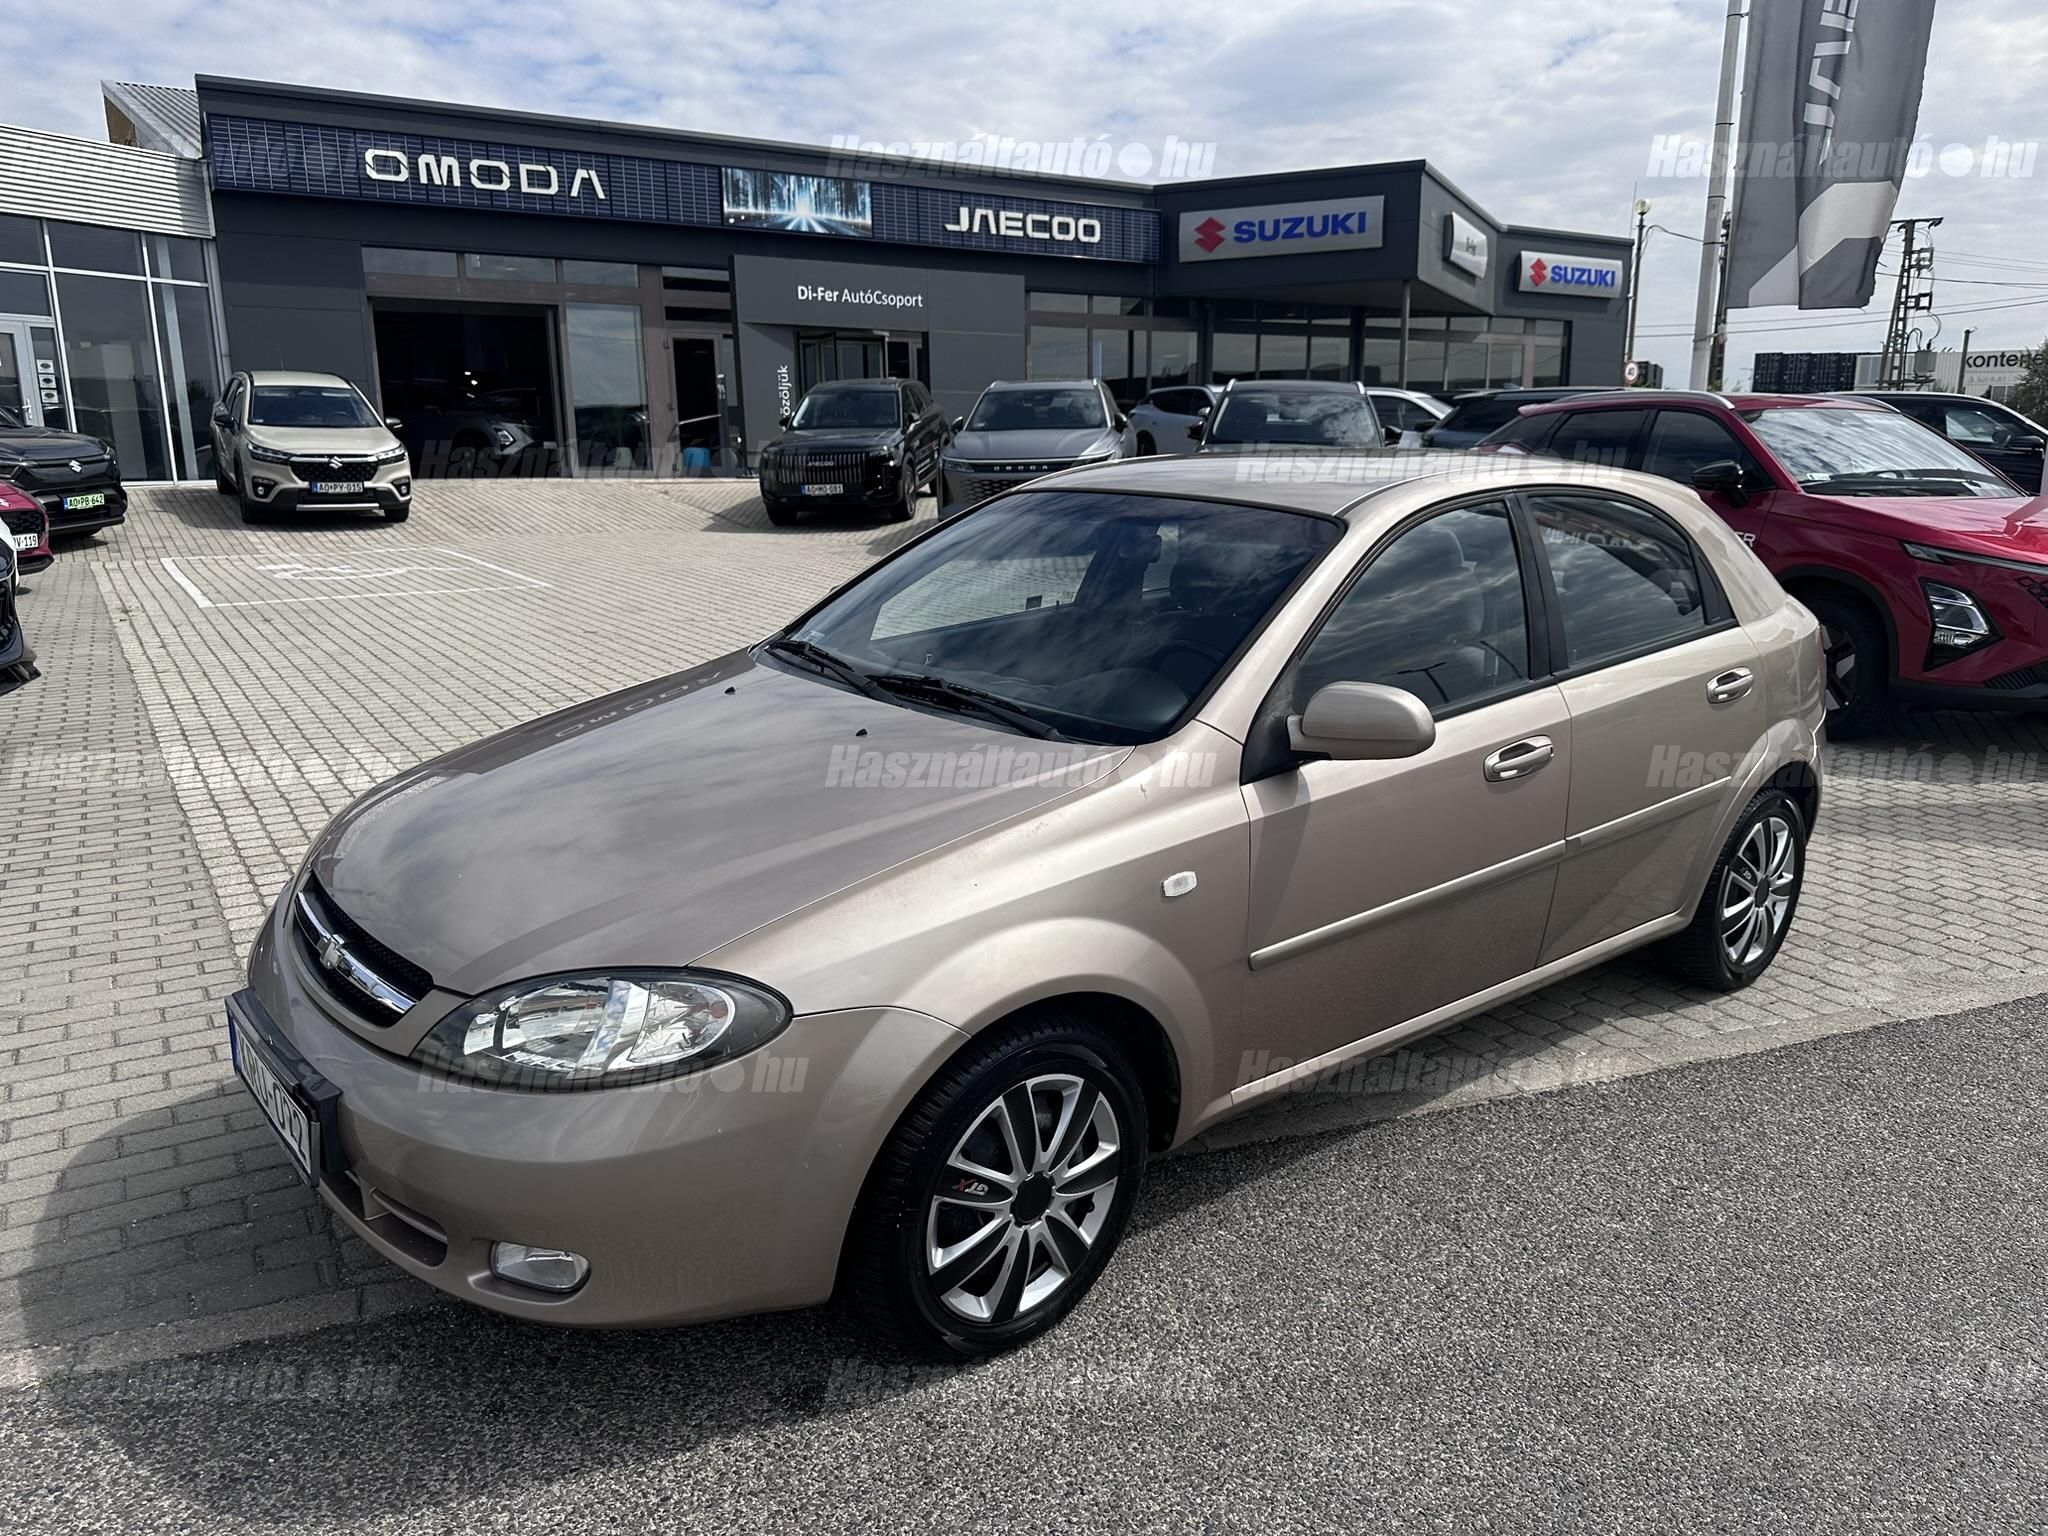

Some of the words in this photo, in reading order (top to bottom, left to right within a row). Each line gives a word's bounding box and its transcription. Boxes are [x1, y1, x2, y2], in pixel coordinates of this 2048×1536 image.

[365, 149, 606, 199] OMODA
[944, 207, 1101, 243] JAECOO
[1233, 211, 1367, 243] SUZUKI
[1550, 265, 1616, 288] SUZUKI
[797, 285, 839, 302] Di-Fer
[841, 288, 923, 309] AutóCsoport
[777, 365, 792, 418] özöljük
